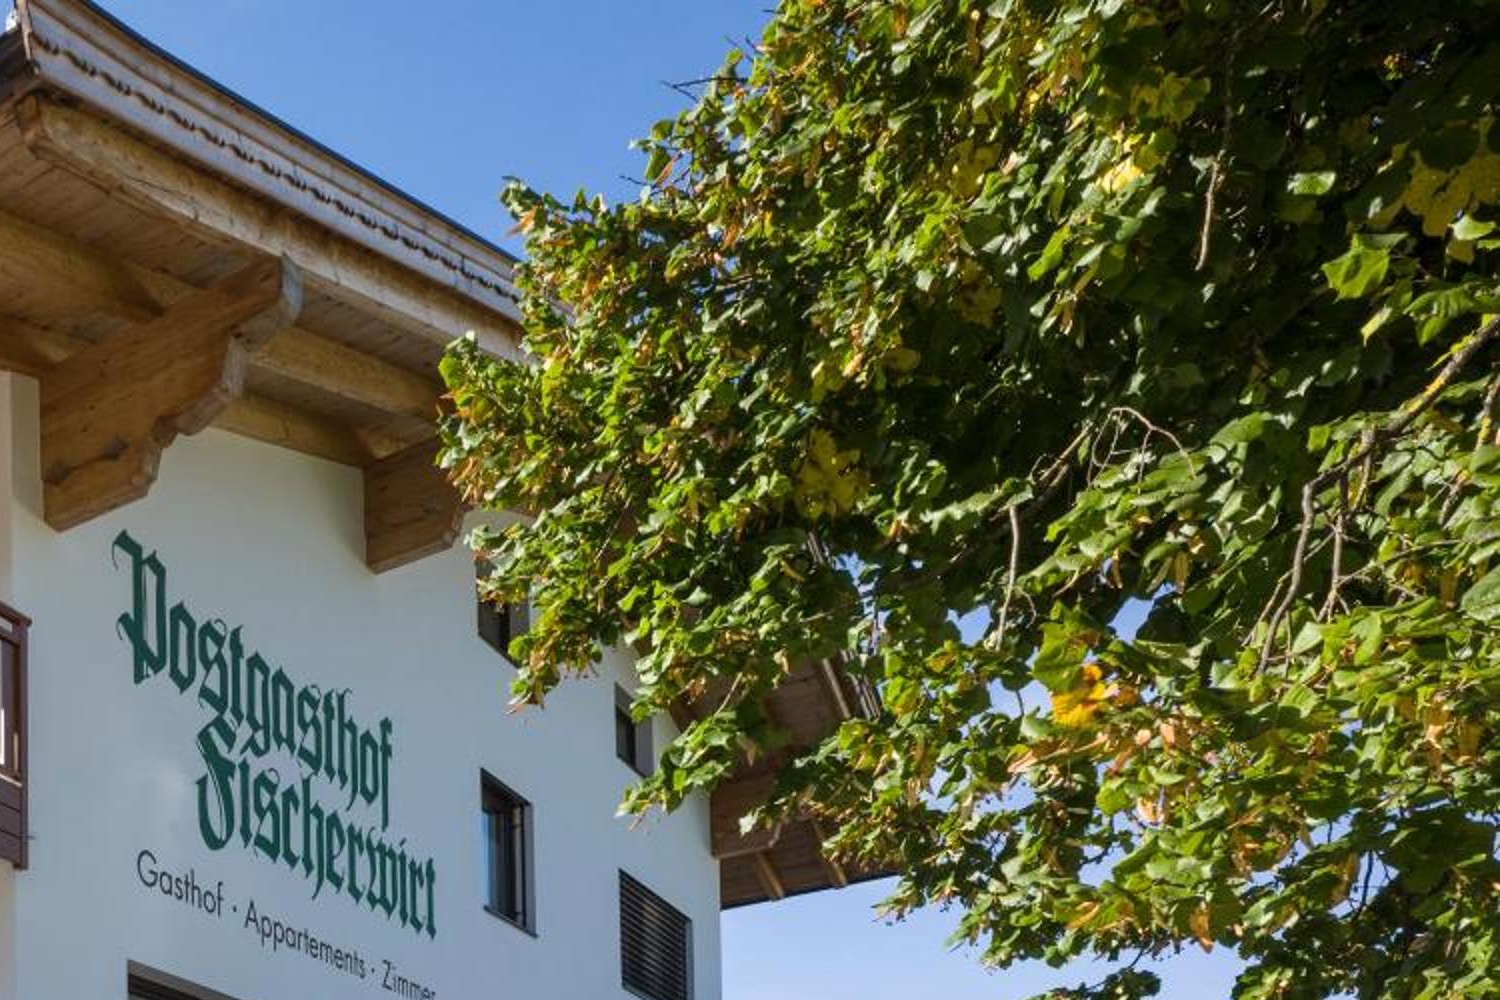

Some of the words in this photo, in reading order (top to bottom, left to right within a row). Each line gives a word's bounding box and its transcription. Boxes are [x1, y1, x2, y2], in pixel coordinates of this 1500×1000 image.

[112, 529, 392, 831] Postgasthof
[137, 850, 225, 917] Gasthof
[244, 900, 366, 979] Appartements
[196, 716, 437, 939] Fischerwirt
